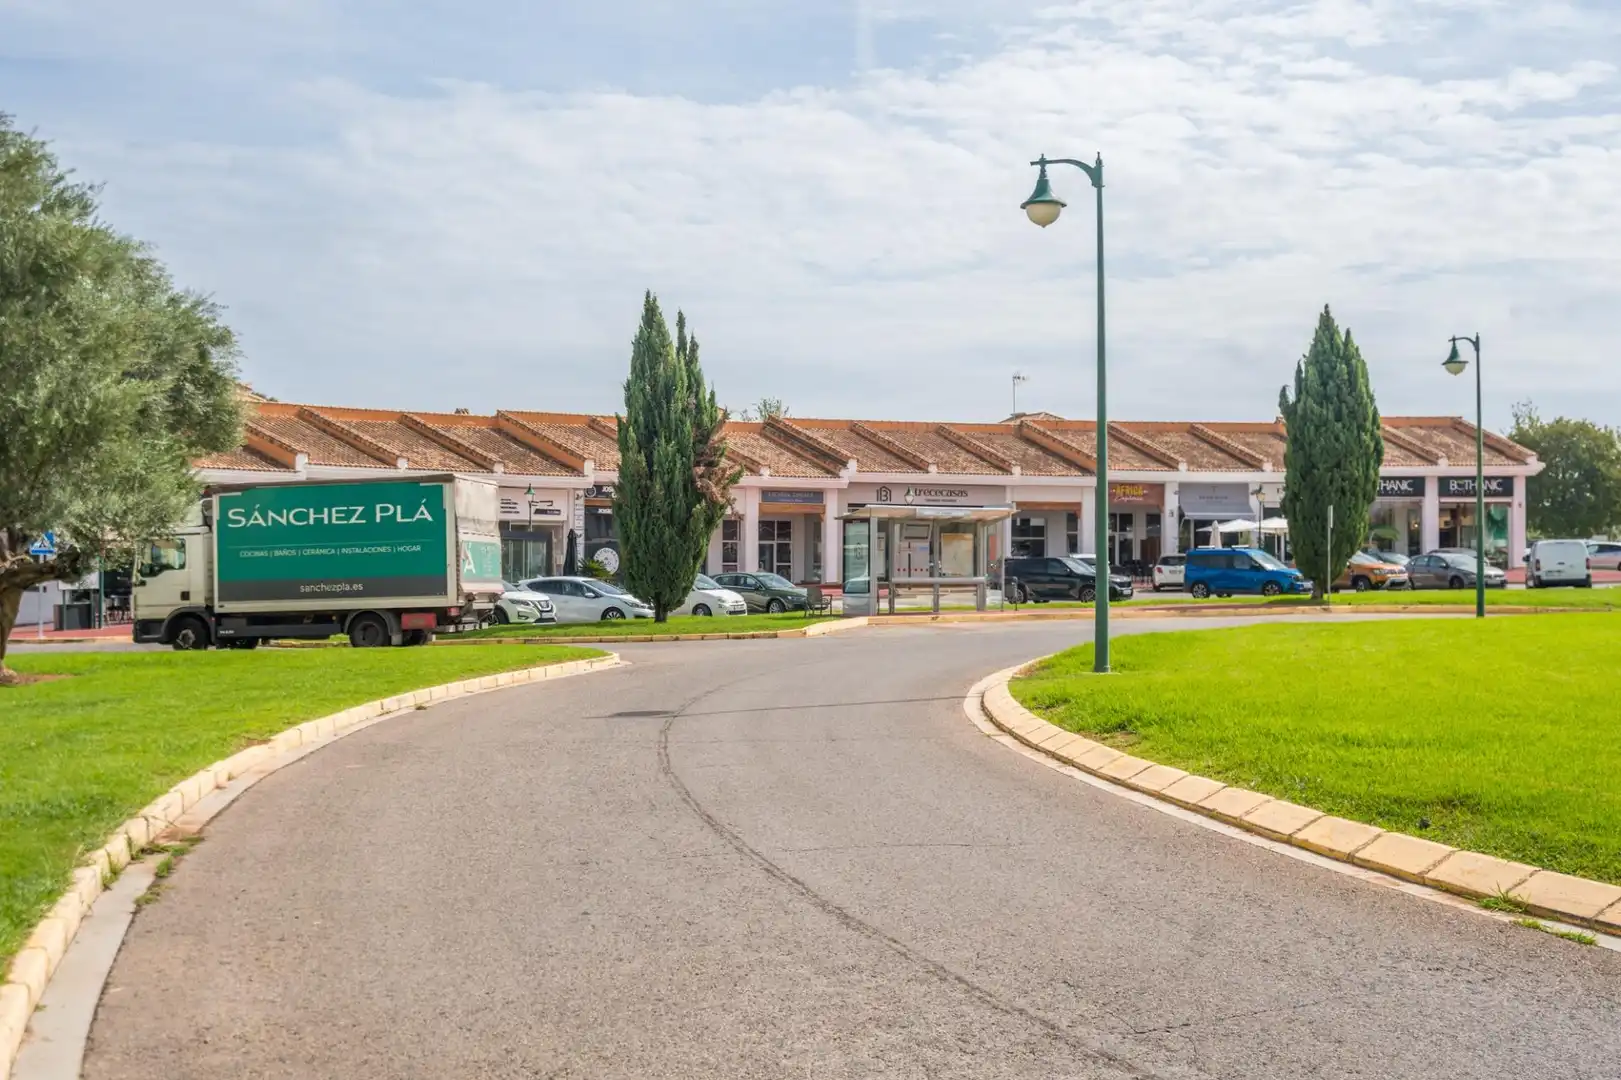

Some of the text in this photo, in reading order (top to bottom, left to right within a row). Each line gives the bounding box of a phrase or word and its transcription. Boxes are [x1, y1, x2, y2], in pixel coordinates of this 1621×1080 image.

[1376, 479, 1414, 491] THANIC
[1449, 479, 1503, 491] BOTHNIC
[227, 498, 434, 528] SÁNCHEZ PLÁ
[274, 547, 296, 556] BAÑOS
[302, 547, 335, 555] CERÁMICA
[341, 546, 392, 554] INSTALACIONES
[299, 581, 364, 593] sanchezpla.es
